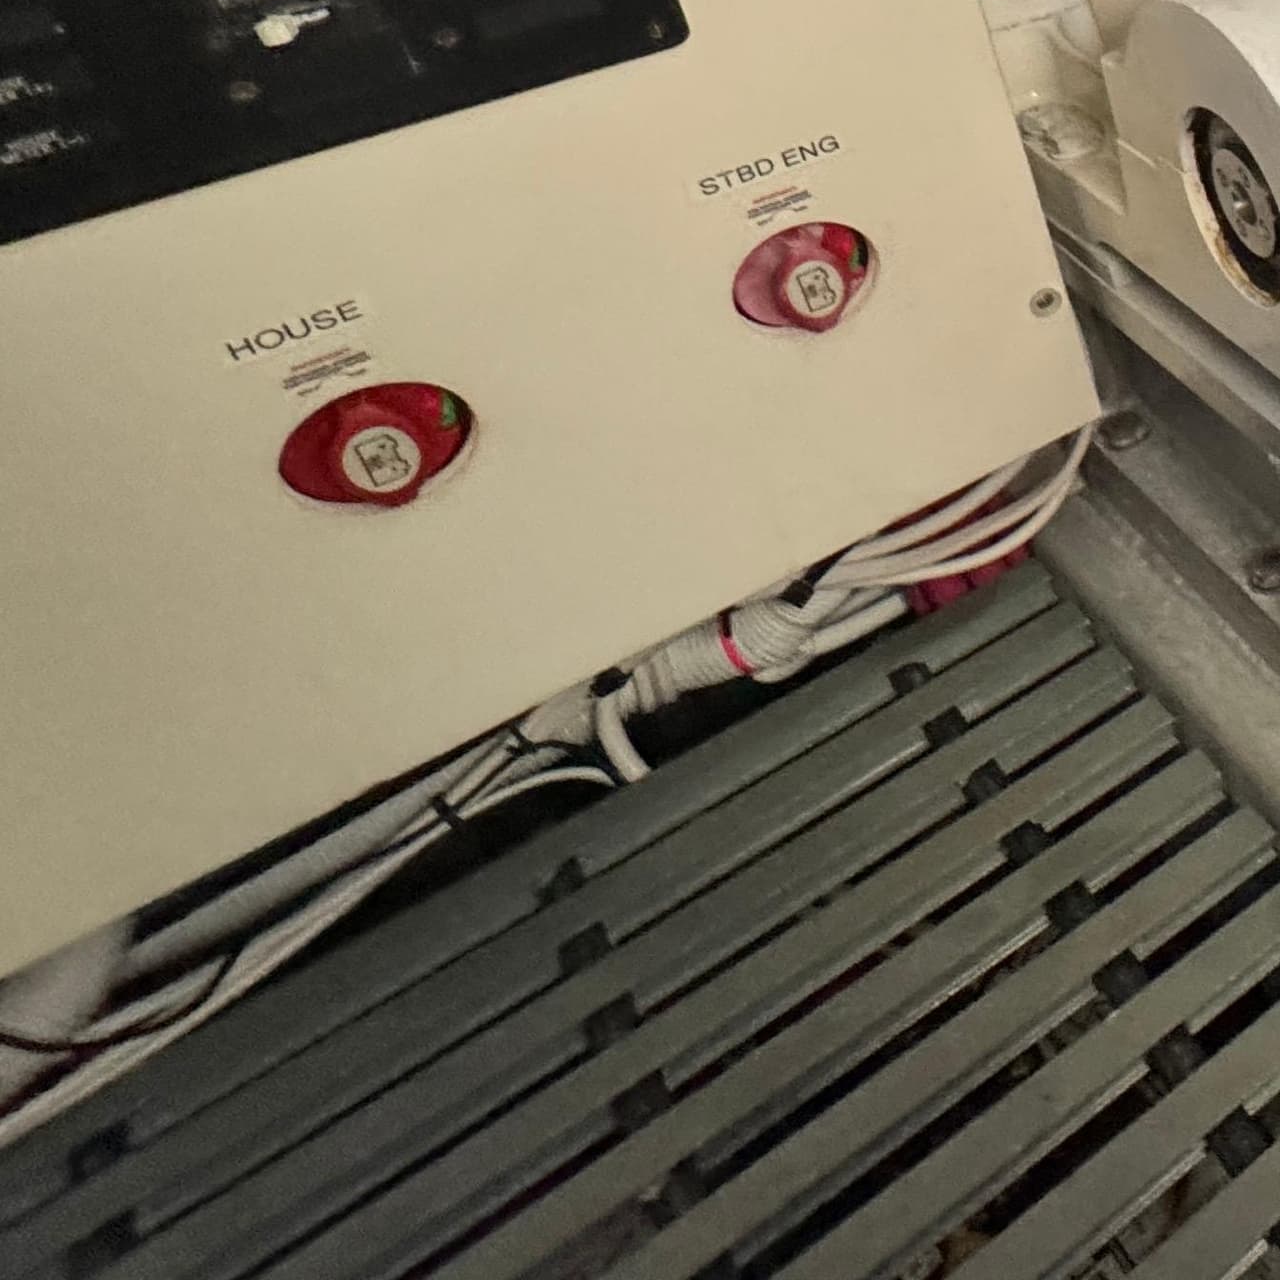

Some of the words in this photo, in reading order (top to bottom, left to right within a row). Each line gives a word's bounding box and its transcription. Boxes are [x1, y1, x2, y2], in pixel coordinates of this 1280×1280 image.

[699, 158, 775, 196] STBD
[781, 135, 840, 168] ENG
[225, 300, 363, 361] HOUSE
